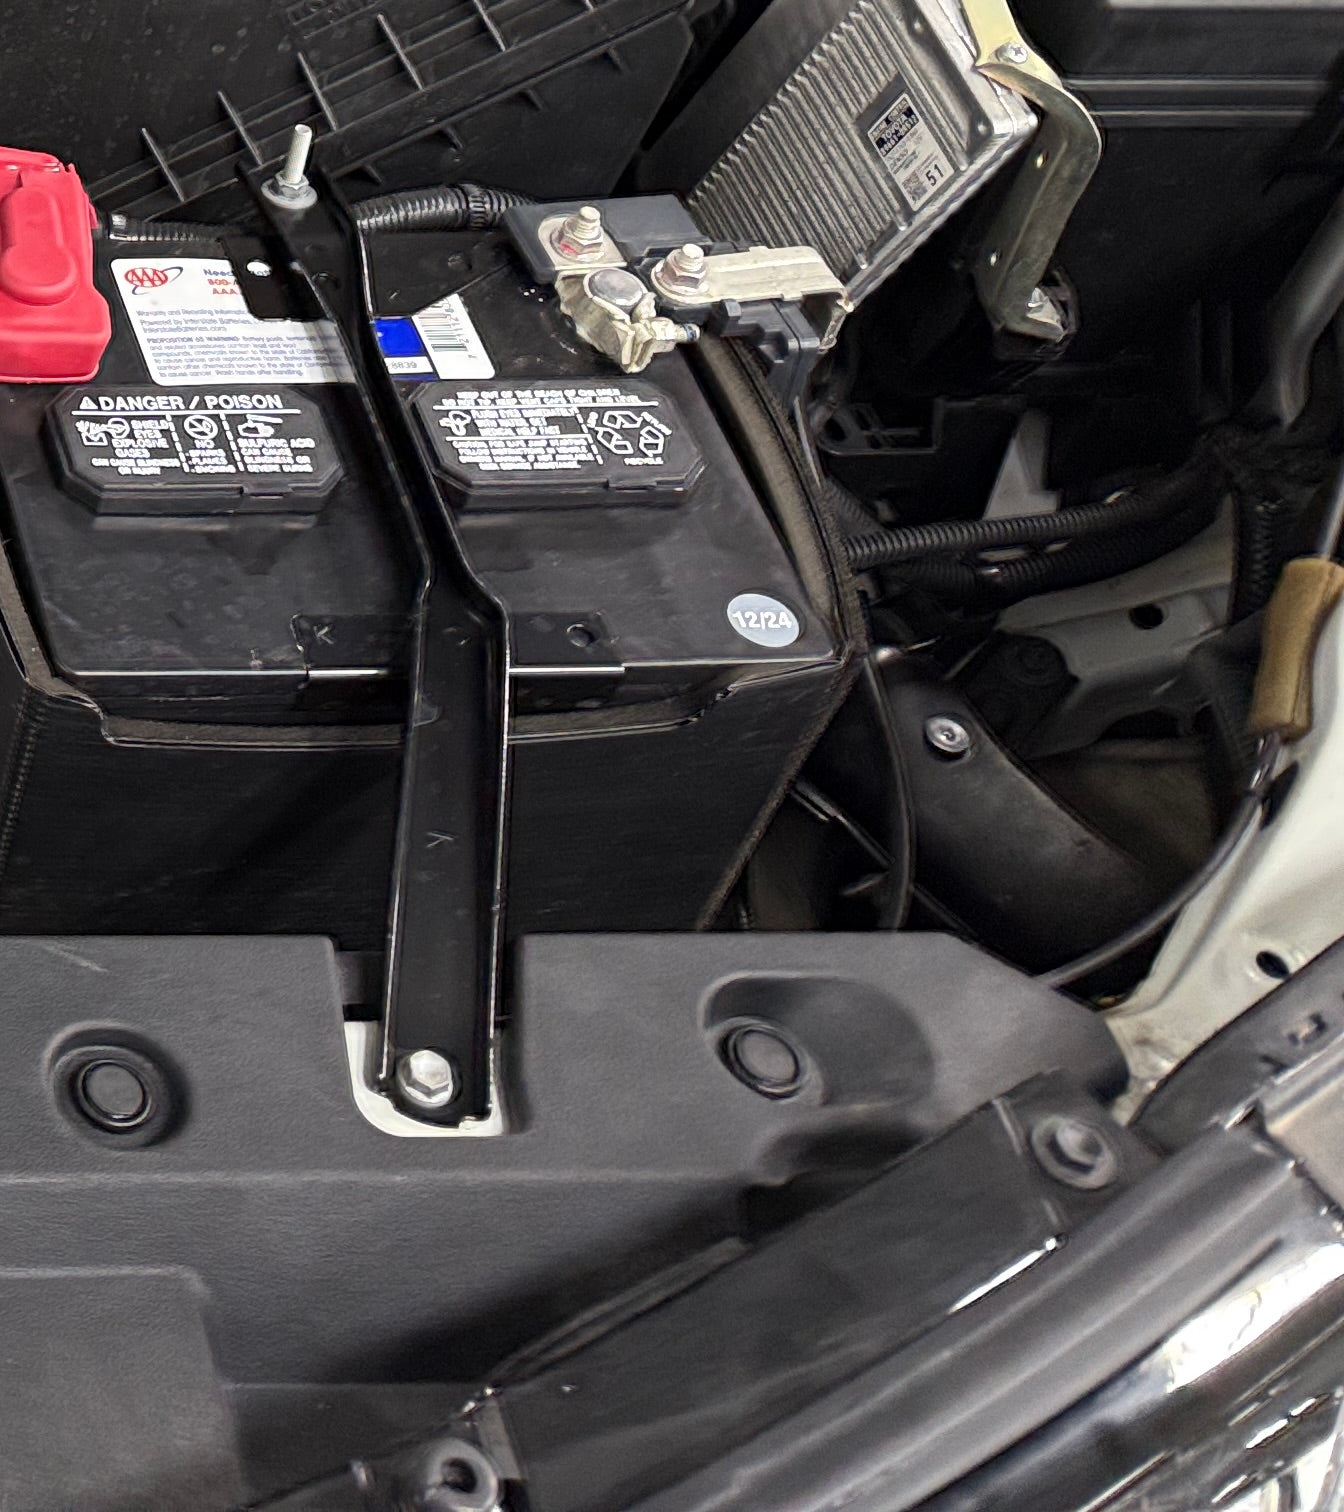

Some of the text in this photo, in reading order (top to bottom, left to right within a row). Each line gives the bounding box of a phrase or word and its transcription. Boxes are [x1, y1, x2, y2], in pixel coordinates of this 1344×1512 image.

[881, 113, 909, 142] TOYOTA
[925, 163, 944, 187] 51
[130, 268, 166, 285] AAA
[98, 395, 283, 410] DANGER / POISON
[131, 420, 169, 430] SHIELD
[133, 429, 162, 438] EYES
[112, 438, 169, 448] EXPLOSIVE
[194, 439, 214, 448] NO
[237, 438, 315, 448] SULFURIC ACID
[732, 611, 792, 630] 12/24
